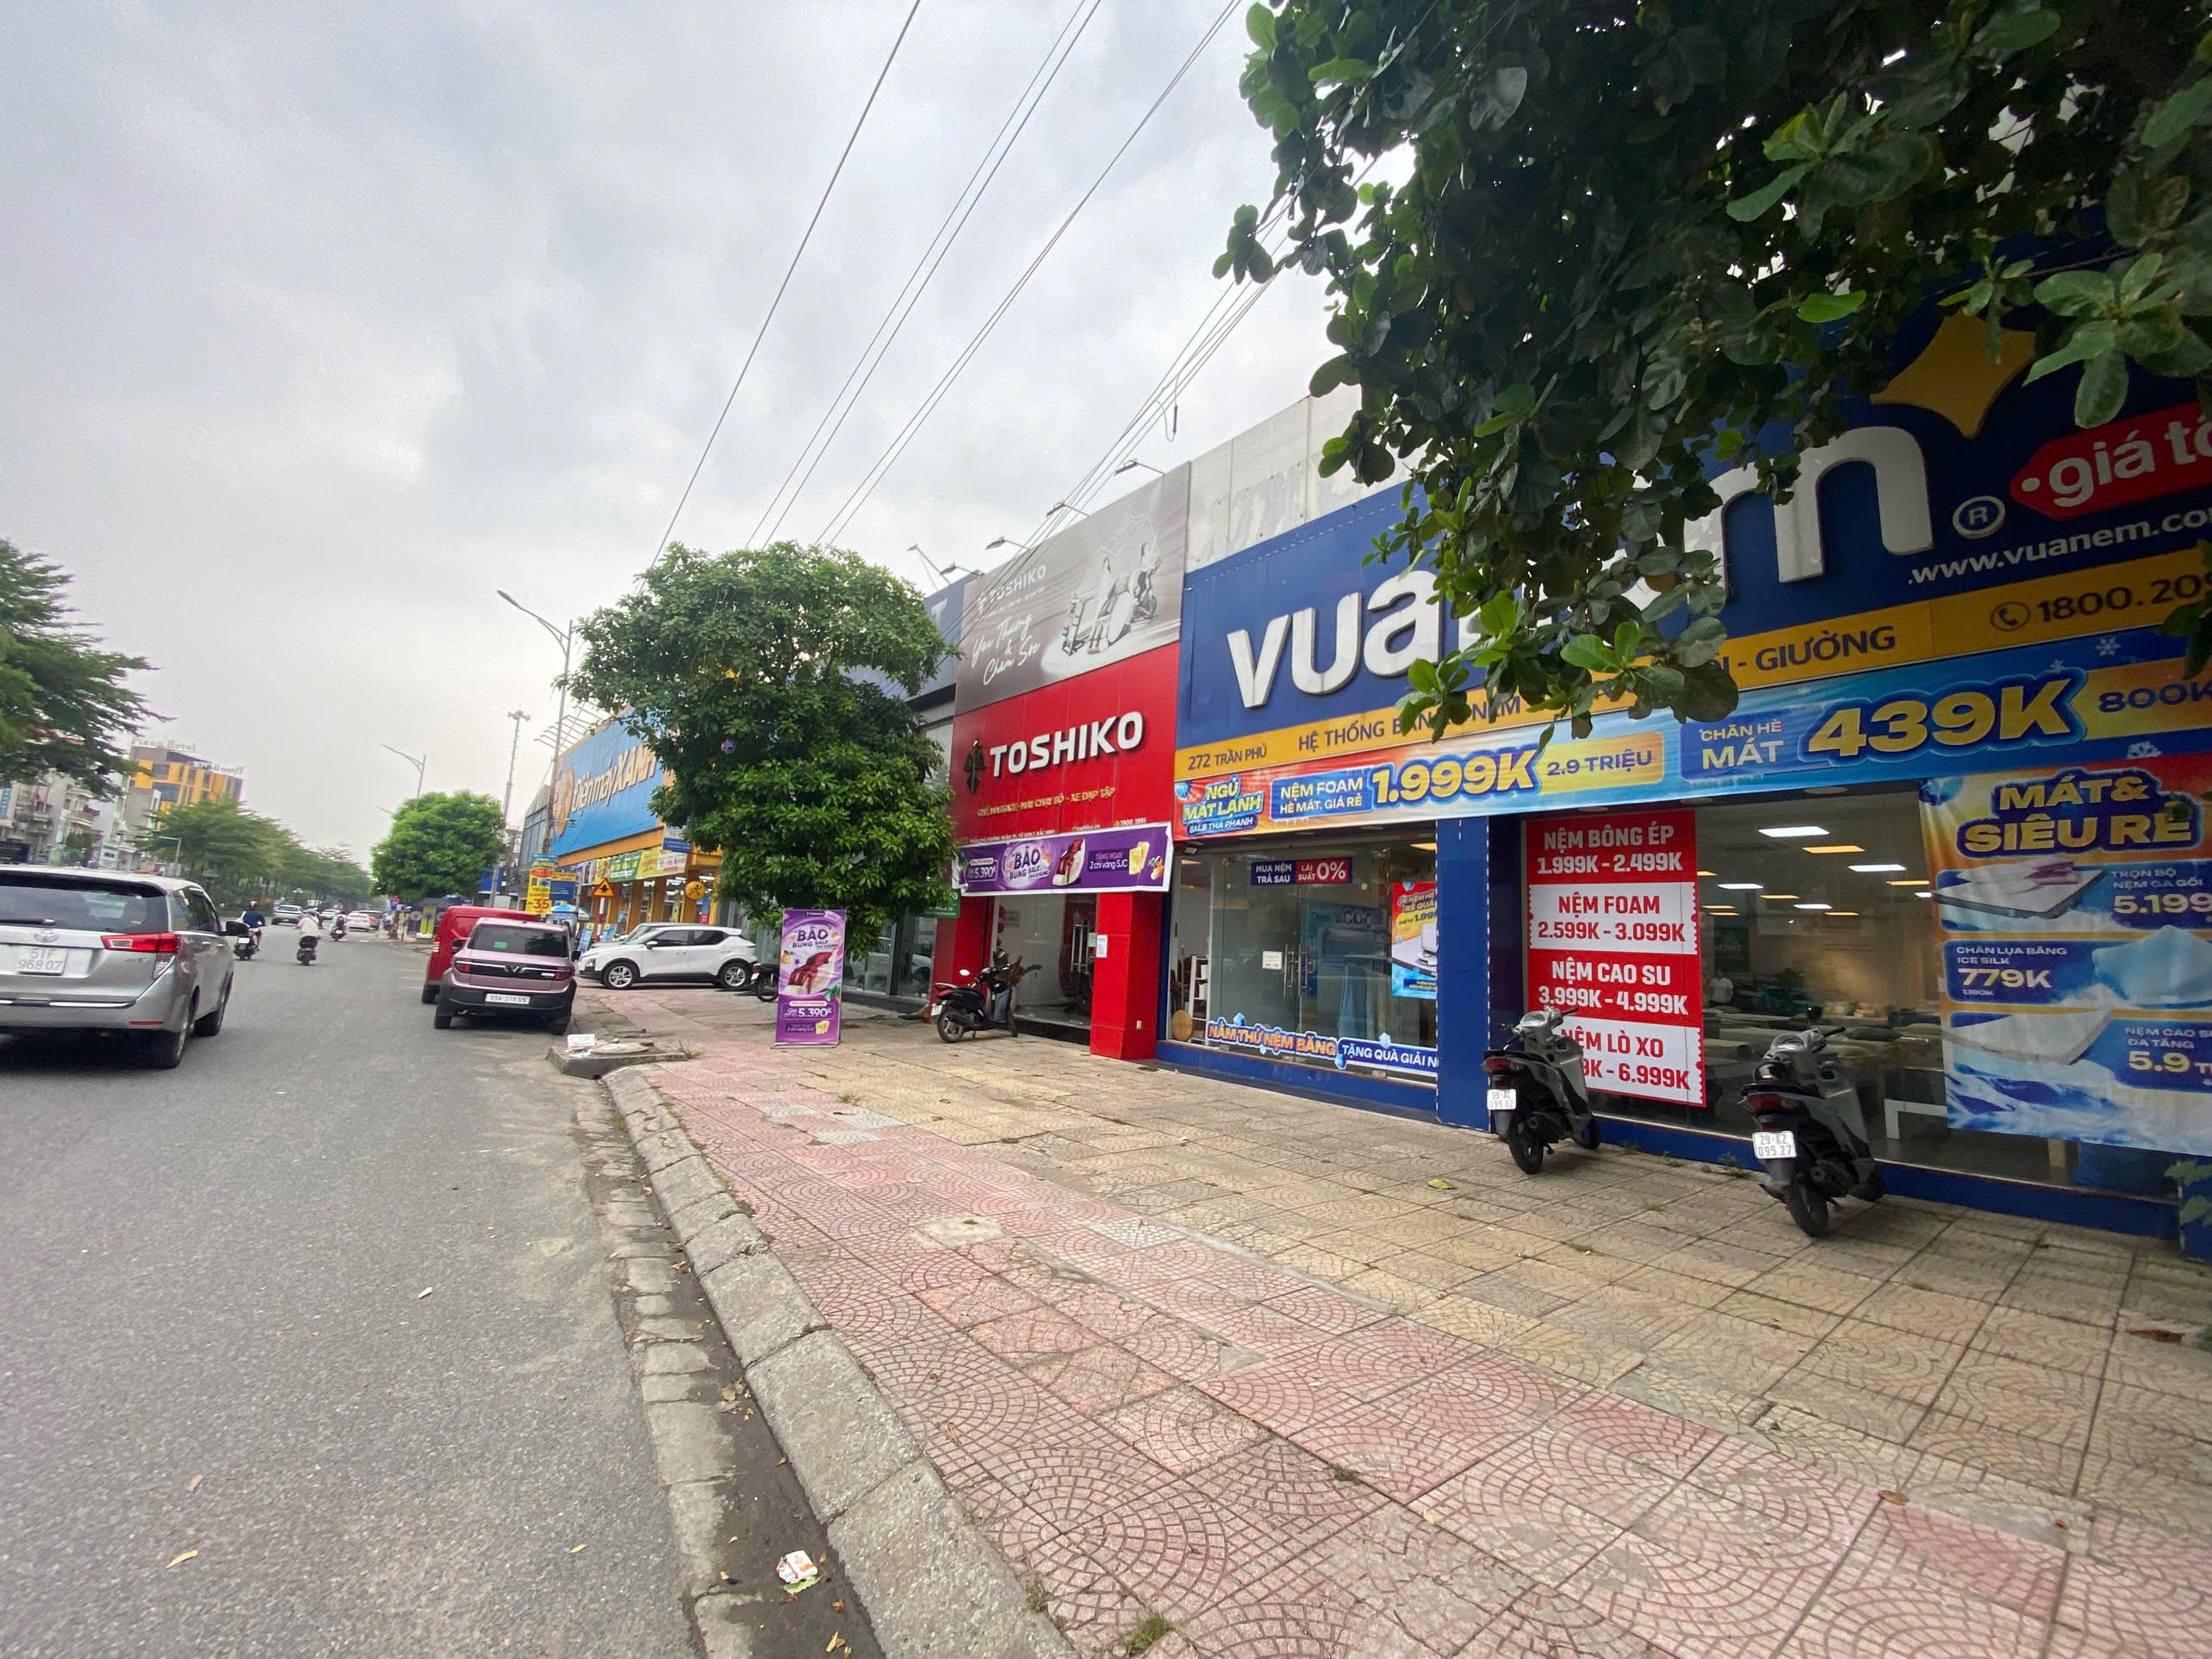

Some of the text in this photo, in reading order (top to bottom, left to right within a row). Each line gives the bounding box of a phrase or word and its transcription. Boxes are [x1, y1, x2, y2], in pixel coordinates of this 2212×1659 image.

[2047, 426, 2154, 508] giá
[1910, 506, 2212, 584] www.vuanem.co
[989, 564, 1047, 603] TOSHIKO
[1755, 626, 1896, 671] GIƯỜNG
[1808, 678, 2071, 758] 439K
[1298, 724, 1320, 754] HỆ
[1323, 711, 1385, 747] THỐNG
[1700, 719, 1782, 743] CHĂN HÈ
[989, 711, 1145, 778] TOSHIKO
[1702, 736, 1784, 771] MÁT
[612, 743, 658, 793] XANH
[1188, 755, 1210, 770] 272
[1214, 749, 1242, 766] TRẦN
[1547, 749, 1653, 776] 2.9 TRIỆU
[1280, 777, 1364, 799] NỆM FOAM
[1372, 749, 1538, 804] 1.999K
[1184, 795, 1262, 821] MÁT LẠNH
[1280, 801, 1294, 814] HÈ
[1324, 794, 1345, 809] GIÁ
[1346, 792, 1363, 807] RẺ
[1189, 823, 1207, 834] SALE
[1226, 817, 1253, 829] PHANH
[1544, 821, 1675, 854] NỆM BÔNG ÉP
[1965, 813, 2098, 853] SIÊU
[1028, 866, 1041, 874] SALE
[1090, 861, 1094, 869] 2
[1275, 861, 1292, 873] NỆM
[1316, 861, 1346, 880] 0%
[1538, 855, 1599, 874] 1.999K
[1613, 852, 1683, 873] 2.499K
[2155, 867, 2178, 878] BỘ
[1273, 874, 1290, 883] SAU
[2113, 879, 2147, 890] NỆM
[532, 898, 550, 910] 35
[1558, 892, 1661, 918] NỆM FOAM
[1538, 922, 1600, 940] 2.599K
[1614, 922, 1686, 942] 3.099K
[30, 948, 56, 960] 51F
[1997, 947, 2024, 955] LỤA
[1551, 957, 1671, 985] NỆM CAO SU
[1957, 968, 2052, 988] 779K
[1538, 985, 1601, 1008] 3.999K
[1616, 992, 1688, 1016] 4.999K
[1264, 1030, 1294, 1051] NỆM
[1296, 1033, 1336, 1056] BĂNG
[1607, 1029, 1631, 1054] LÒ
[1636, 1036, 1664, 1058] XO
[2125, 1027, 2159, 1037] NỆM
[2162, 1028, 2196, 1038] CAO
[1342, 1042, 1372, 1059] TẶNG
[1374, 1047, 1399, 1062] QUÀ
[1401, 1050, 1426, 1066] GIẢI
[2128, 1050, 2190, 1072] 5.9
[1619, 1062, 1691, 1090] 6.999K
